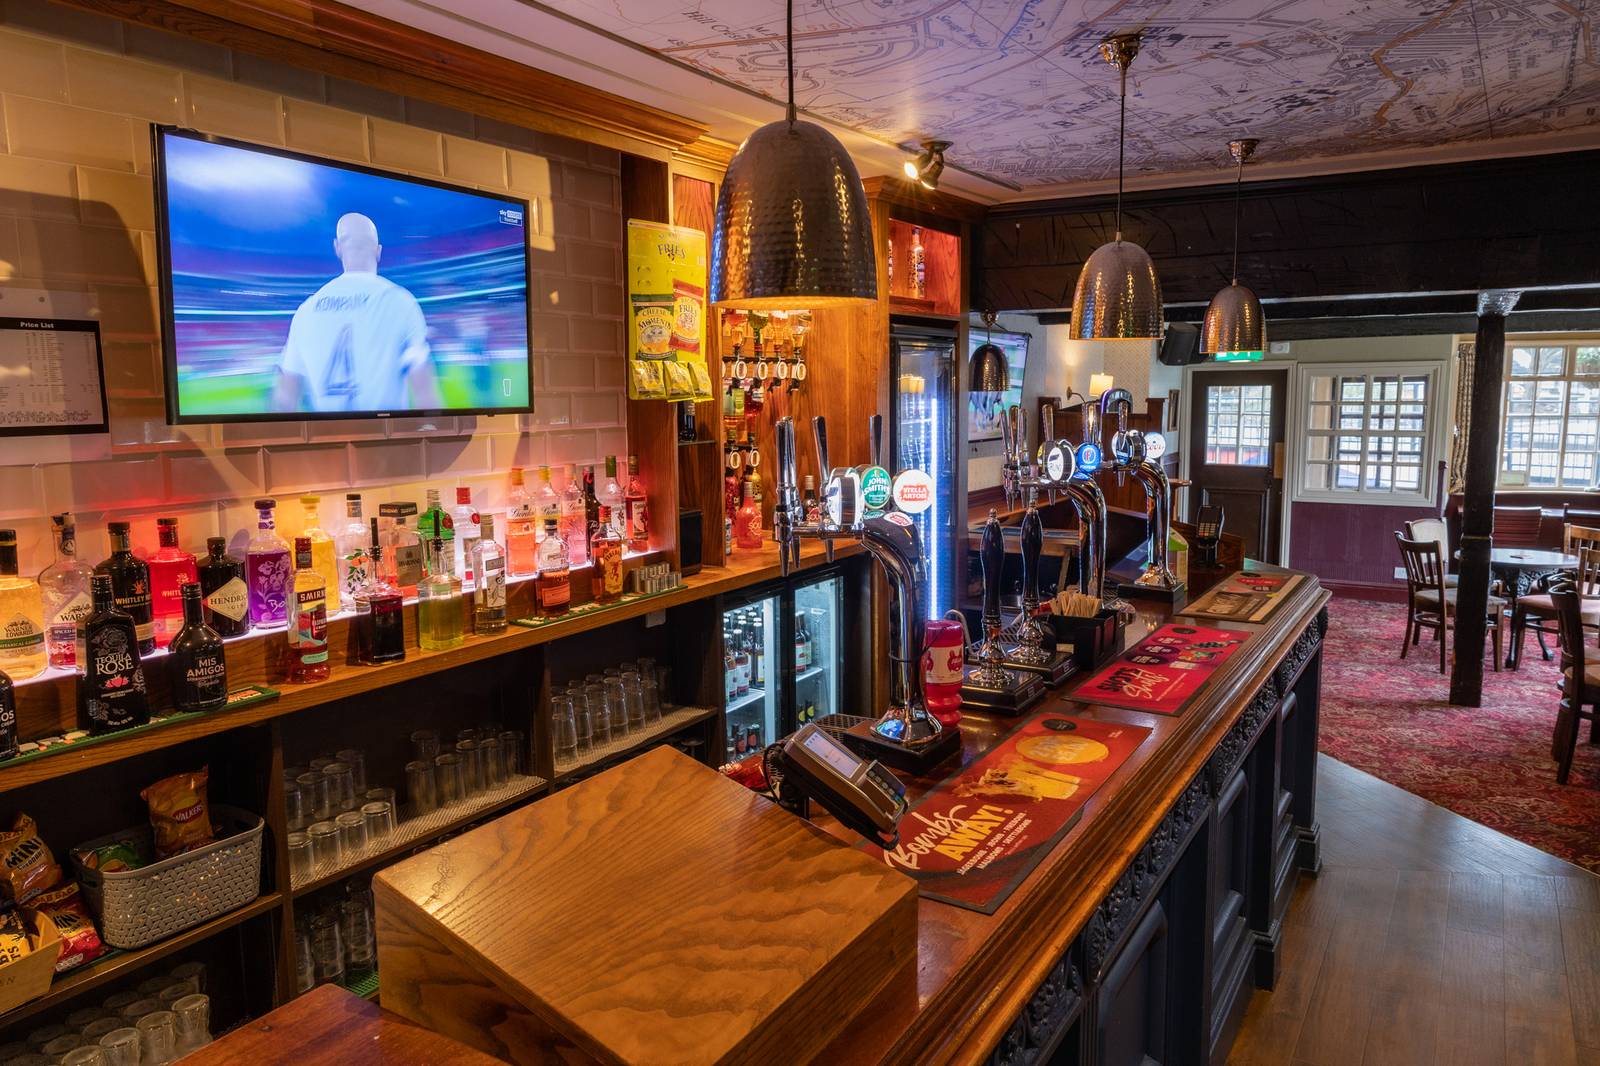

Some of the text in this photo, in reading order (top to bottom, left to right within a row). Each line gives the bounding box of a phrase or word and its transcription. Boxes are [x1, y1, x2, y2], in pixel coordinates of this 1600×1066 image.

[682, 11, 717, 25] Hill
[657, 243, 686, 259] FRIES
[868, 478, 888, 486] JOHN
[115, 597, 145, 605] WHITLEY
[4, 624, 33, 633] WARNER
[94, 652, 132, 665] TEQUILA
[198, 657, 217, 668] MIS
[96, 660, 134, 675] ROSE
[186, 663, 225, 678] AMIGOS
[883, 804, 968, 870] Bombs
[933, 804, 1014, 862] AWAY!
